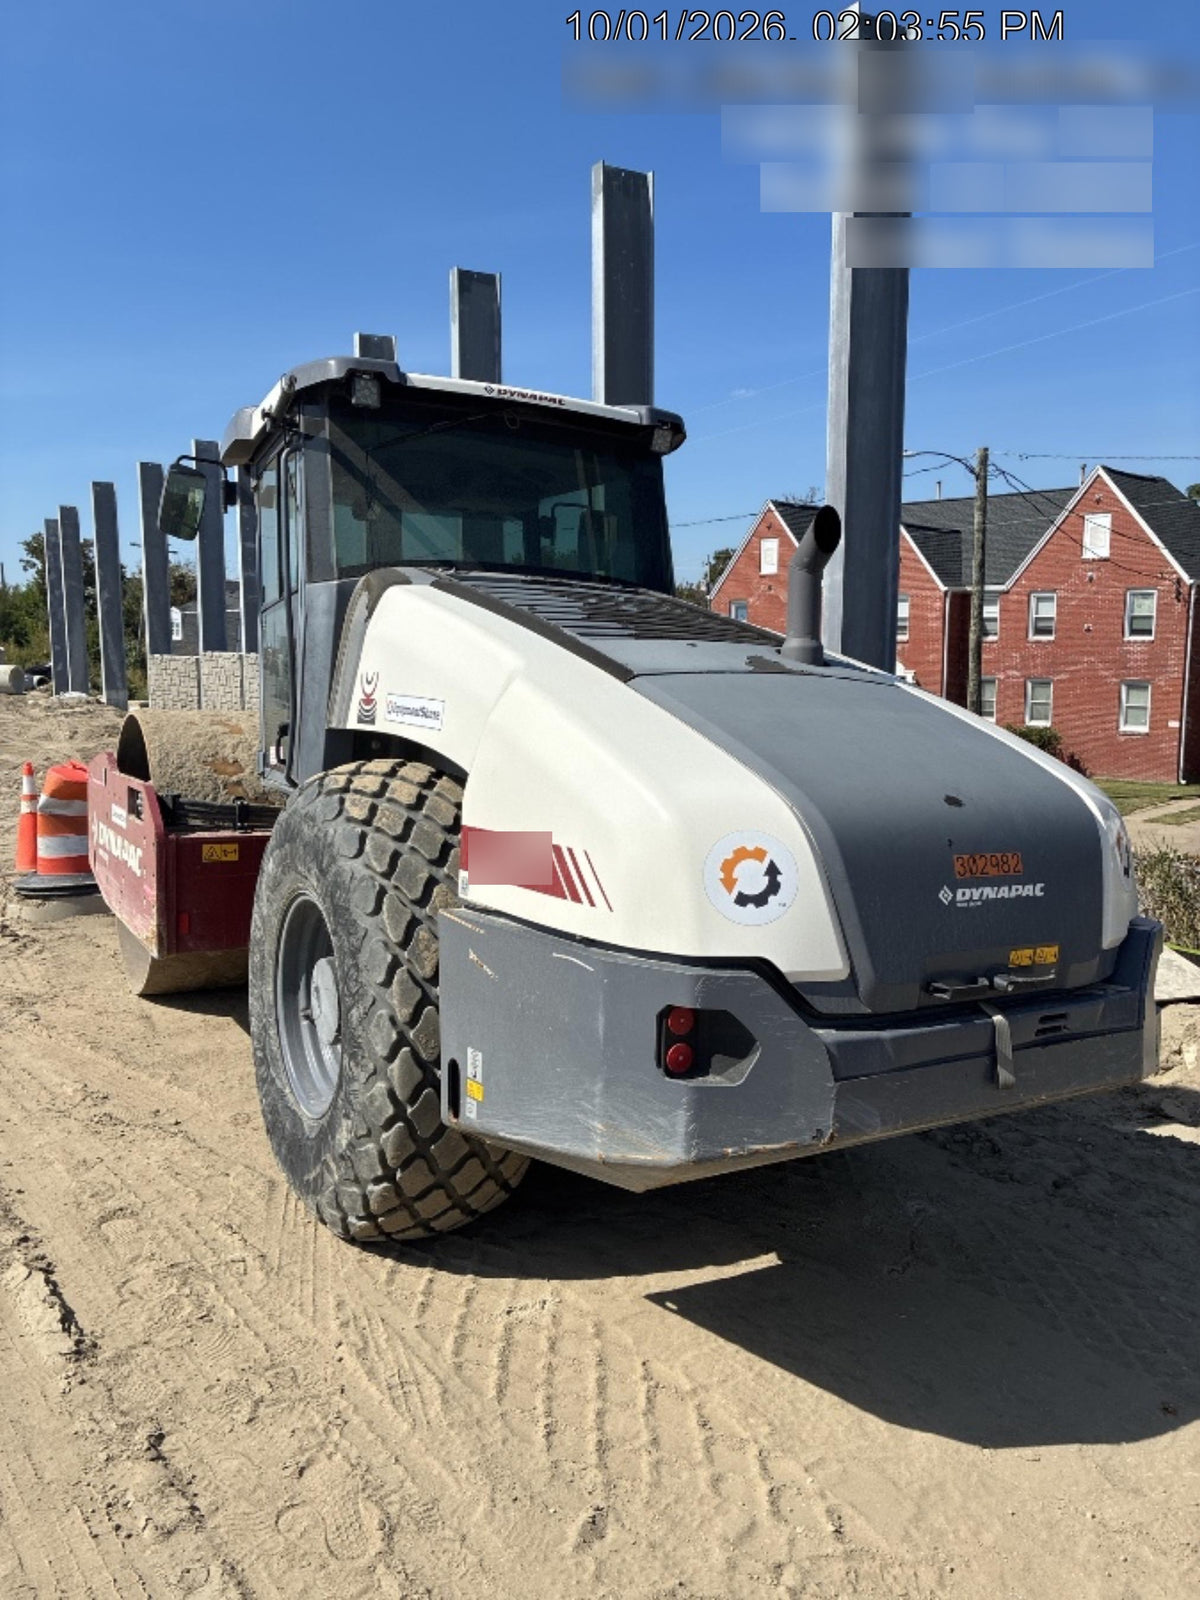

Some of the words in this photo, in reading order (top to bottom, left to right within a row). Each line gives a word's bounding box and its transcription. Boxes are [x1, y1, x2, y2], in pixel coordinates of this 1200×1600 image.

[497, 388, 565, 406] DYNAPAC
[956, 853, 1022, 877] 302982
[956, 883, 1045, 902] DYNAPAC
